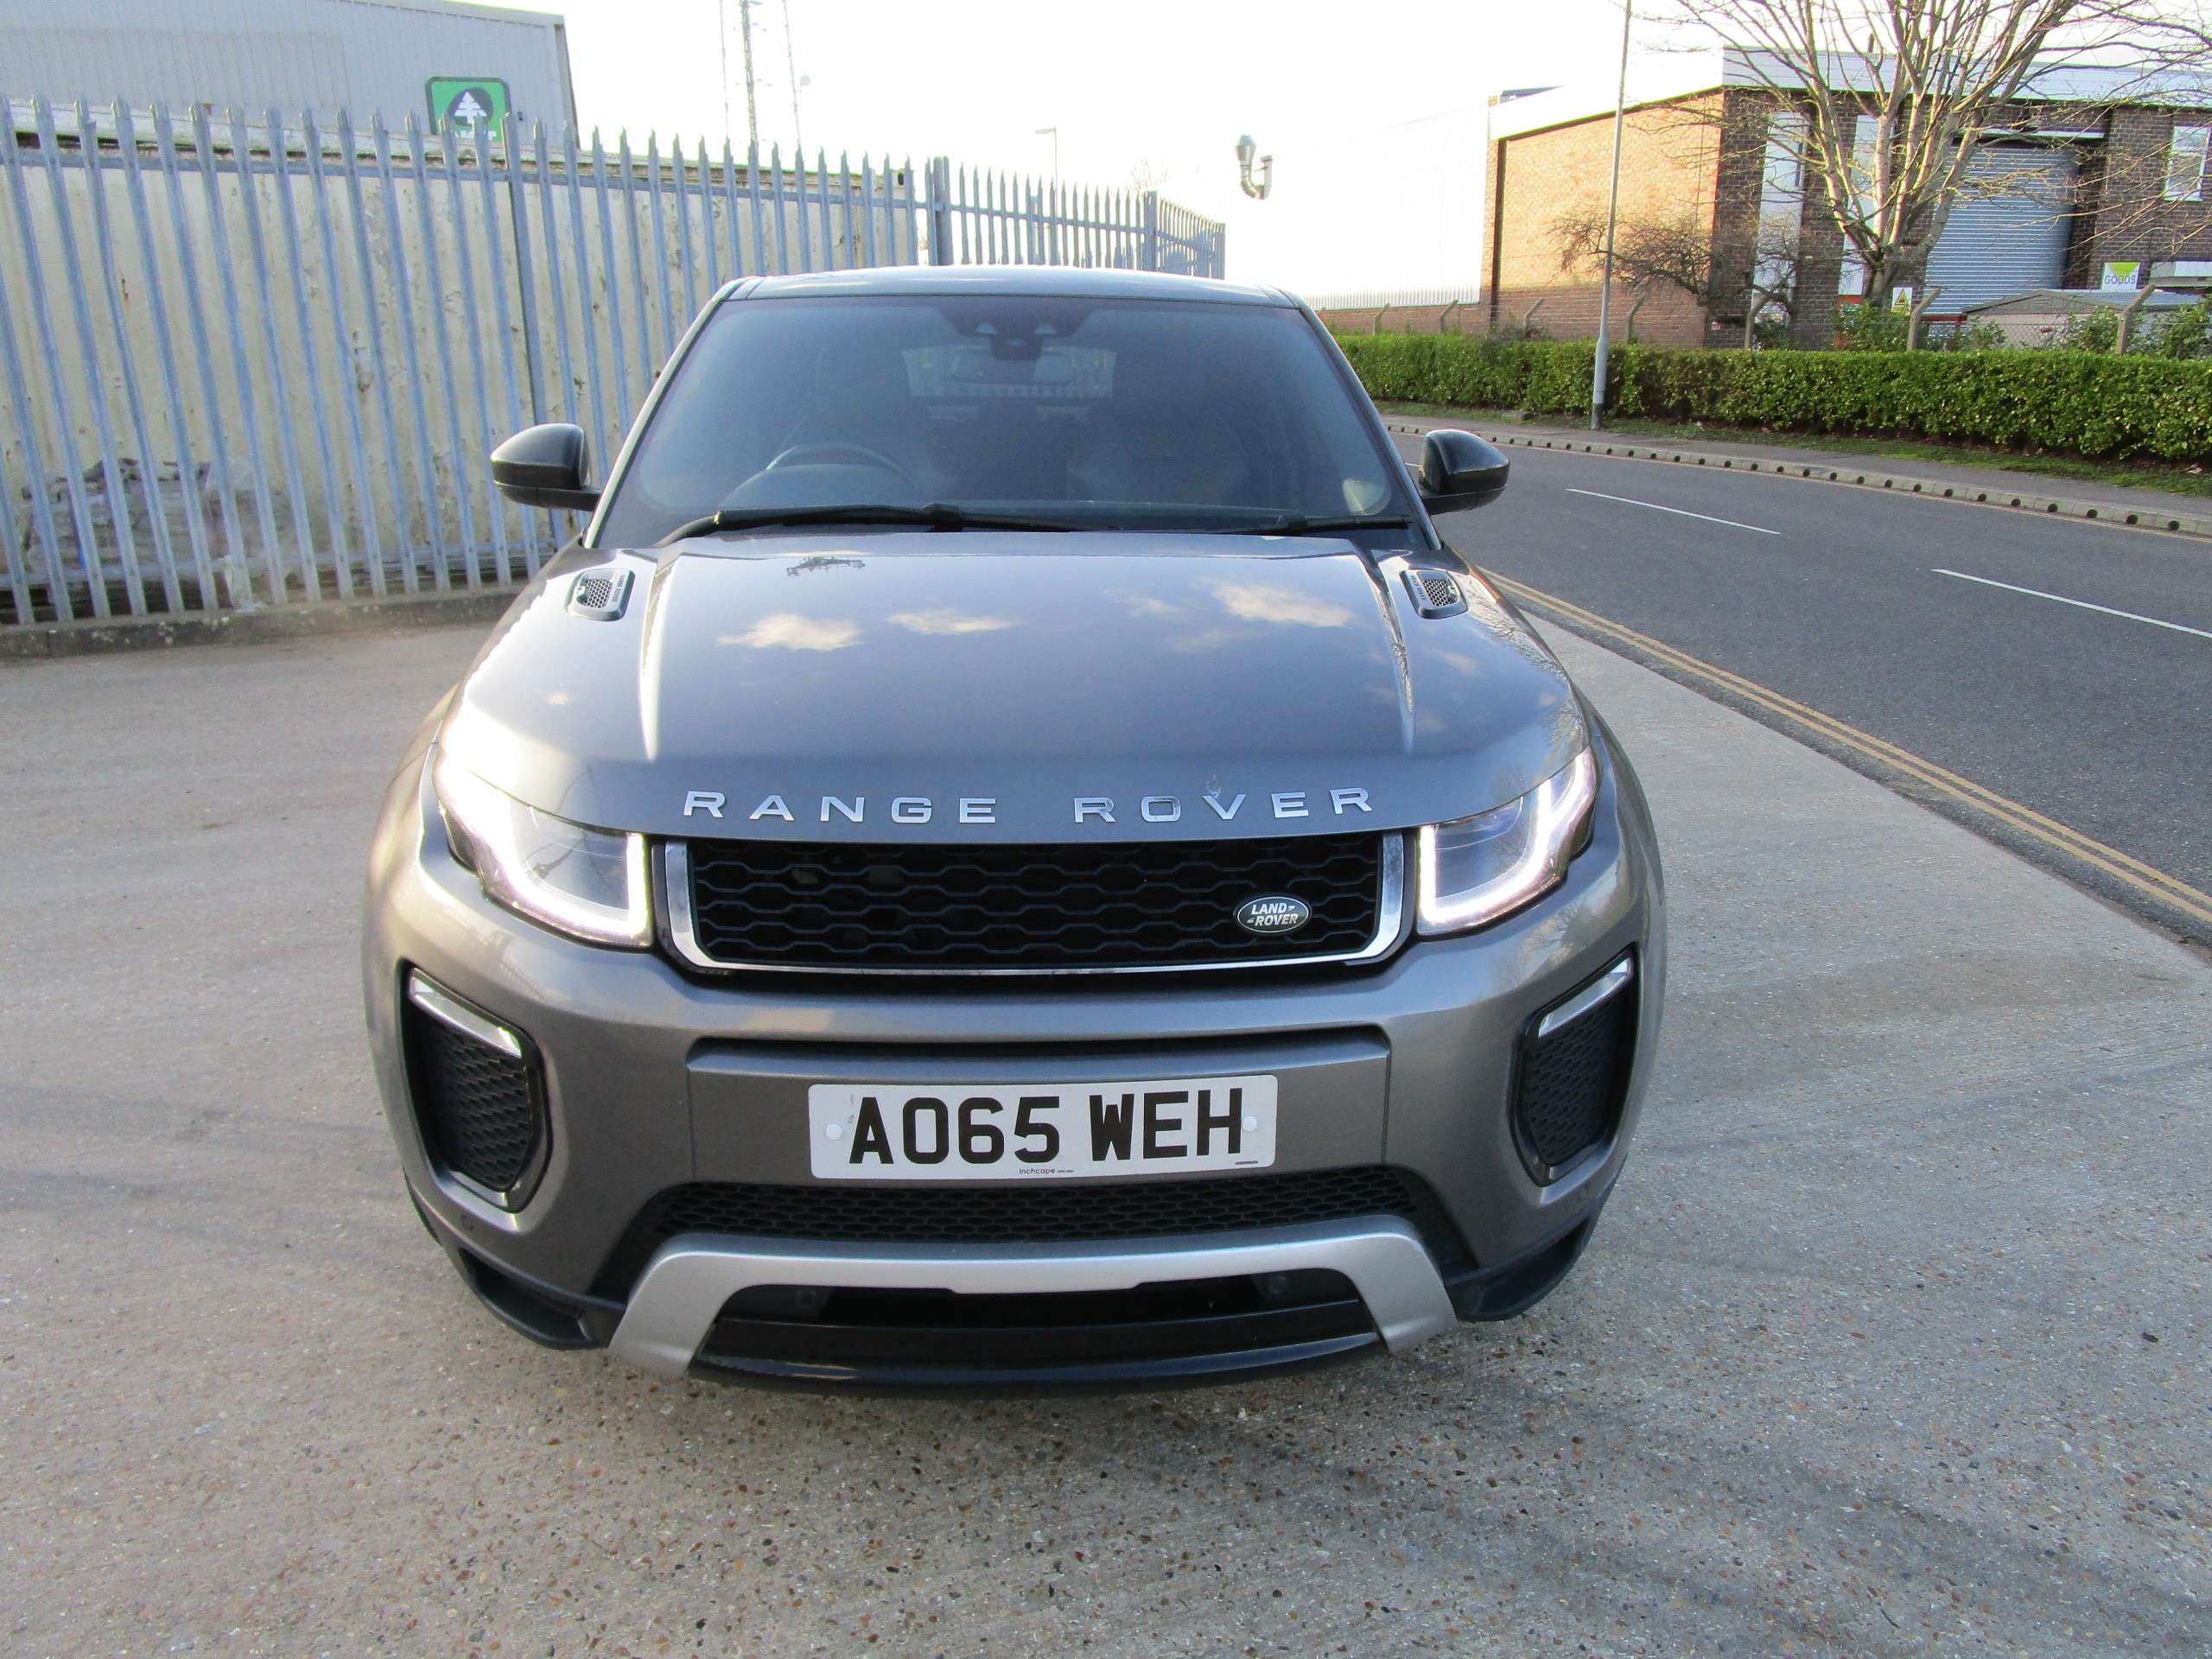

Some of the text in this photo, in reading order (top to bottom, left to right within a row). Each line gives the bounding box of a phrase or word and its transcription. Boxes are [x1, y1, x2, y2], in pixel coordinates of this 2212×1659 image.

[2105, 276, 2137, 284] GOODS
[683, 787, 1373, 825] RANGE ROVER
[1251, 902, 1287, 915] LAND
[1254, 913, 1299, 926] ROVER
[1089, 1087, 1243, 1161] WEH
